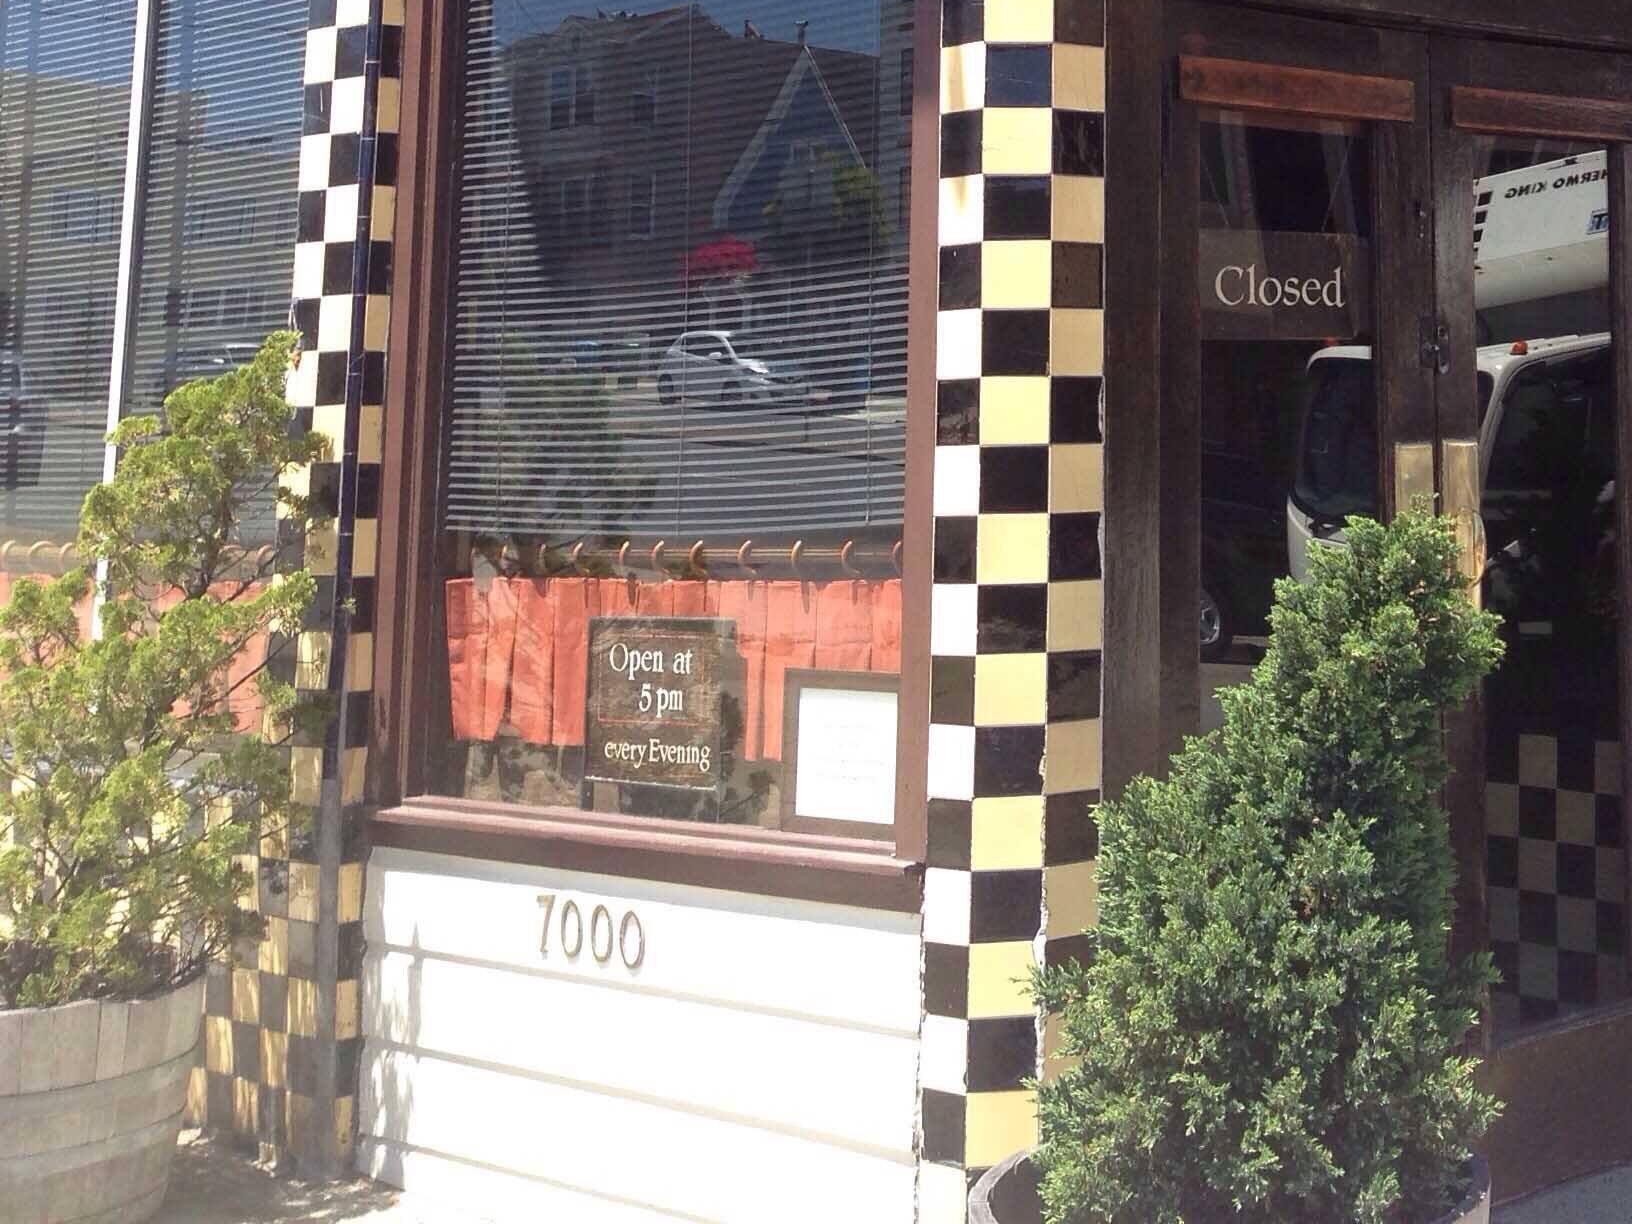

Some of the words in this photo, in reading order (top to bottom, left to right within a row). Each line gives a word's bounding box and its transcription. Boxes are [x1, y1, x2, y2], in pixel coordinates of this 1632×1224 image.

[1214, 263, 1345, 307] Closed
[609, 642, 664, 680] Open
[673, 649, 692, 675] at
[638, 683, 652, 712] 5
[656, 687, 683, 717] pm
[604, 741, 648, 768] every
[649, 738, 711, 772] Evening
[536, 894, 645, 970] 7000
